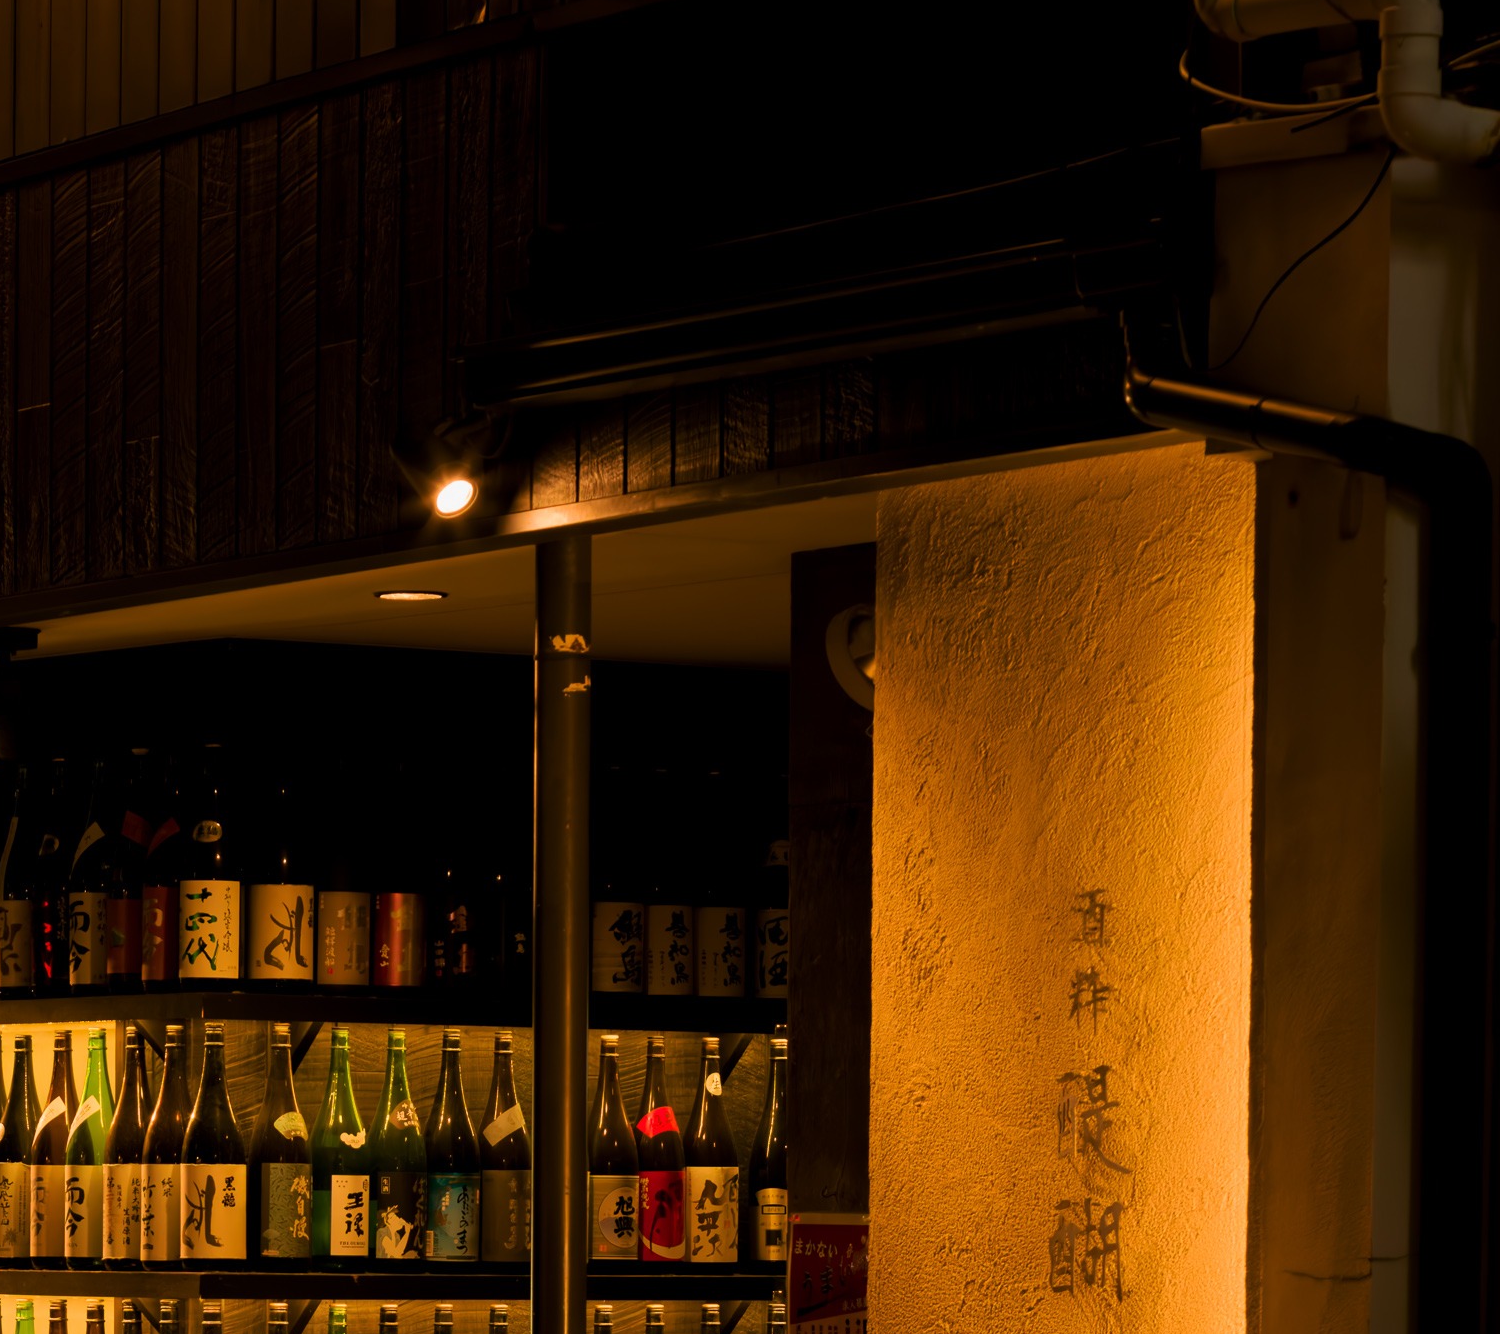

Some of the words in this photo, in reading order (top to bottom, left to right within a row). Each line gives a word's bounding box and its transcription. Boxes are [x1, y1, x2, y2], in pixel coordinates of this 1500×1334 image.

[182, 887, 218, 971] 十四代
[65, 1177, 84, 1238] 而今
[222, 1175, 236, 1208] 黒龍
[290, 1175, 310, 1241] 磯自慢
[613, 1196, 635, 1238] 旭興
